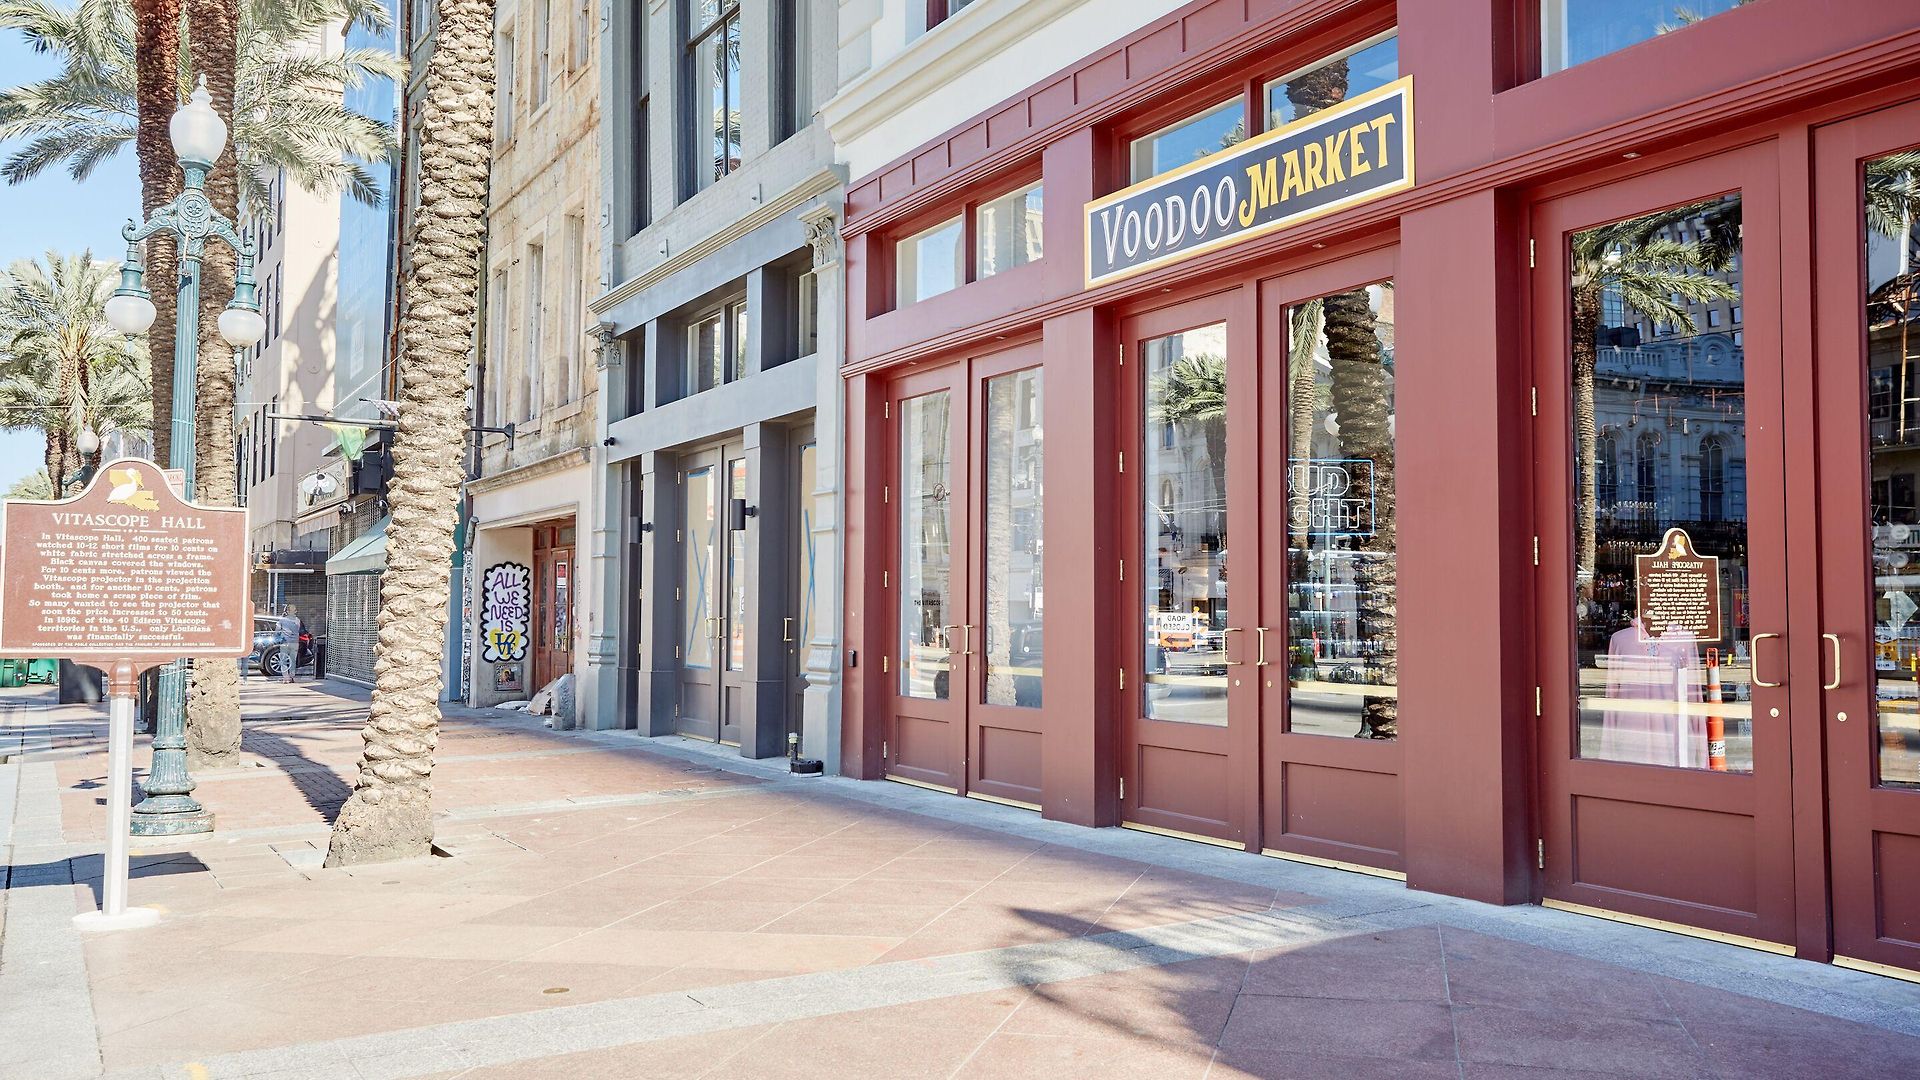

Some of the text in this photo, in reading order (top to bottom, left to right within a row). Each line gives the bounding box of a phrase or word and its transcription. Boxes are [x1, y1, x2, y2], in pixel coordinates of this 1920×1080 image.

[1100, 112, 1396, 268] VOODOO MARKET
[1288, 464, 1350, 496] UD
[52, 513, 205, 529] VITASCOPE HALL
[56, 533, 99, 542] Vitascope
[182, 537, 214, 546] patrons
[131, 568, 163, 576] patrons
[43, 574, 87, 583] Vitascope
[91, 575, 132, 584] projector
[166, 576, 210, 585] projection
[492, 572, 521, 591] ALL
[186, 585, 217, 594] patrons
[140, 593, 163, 601] piece
[494, 591, 519, 606] WE
[159, 601, 199, 609] projector
[86, 608, 109, 616] price
[490, 605, 524, 621] NEED
[165, 617, 206, 625] Vitascope
[500, 620, 513, 632] IS
